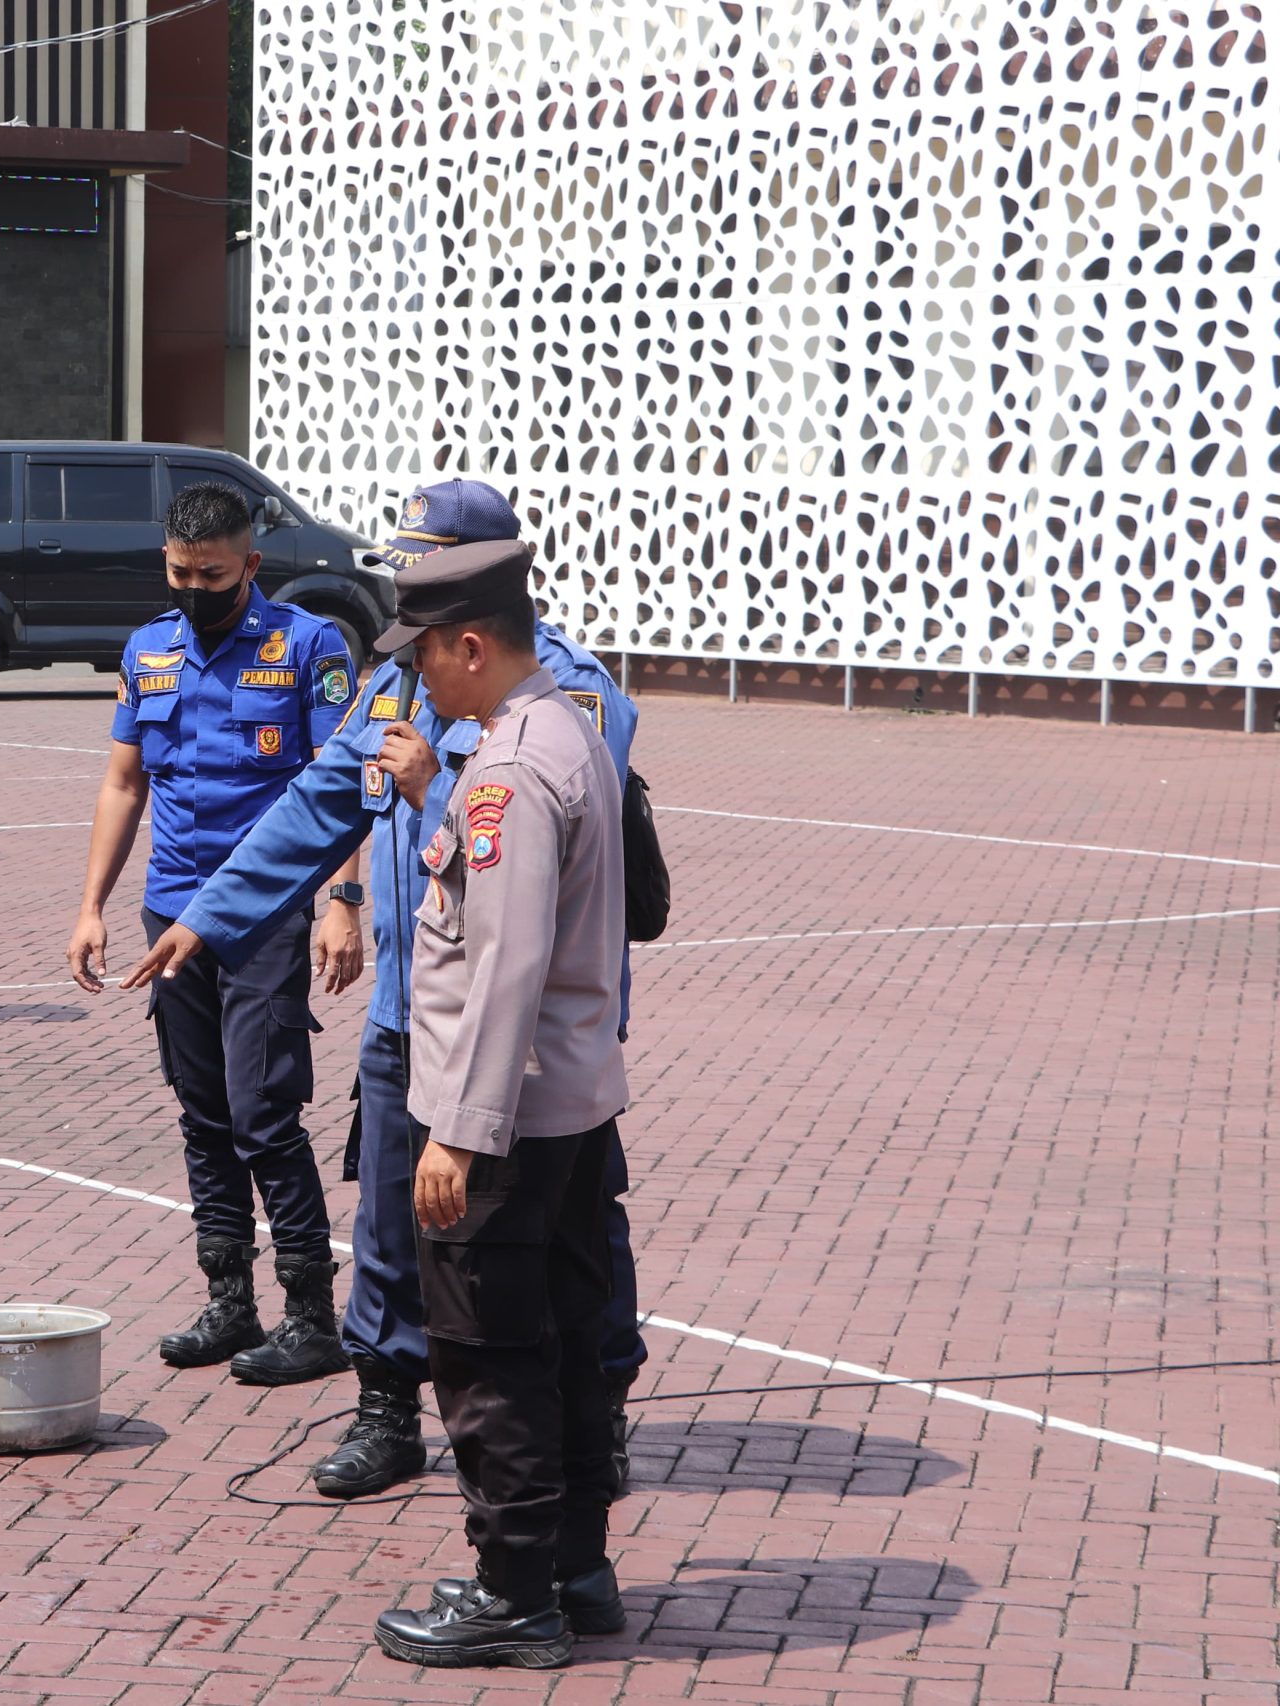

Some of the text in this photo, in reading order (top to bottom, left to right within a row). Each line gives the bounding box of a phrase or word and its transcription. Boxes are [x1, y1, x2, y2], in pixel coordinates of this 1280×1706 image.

[138, 675, 177, 692] MAKRUF
[240, 671, 295, 686] PEMADAM
[468, 785, 507, 804] POLRES
